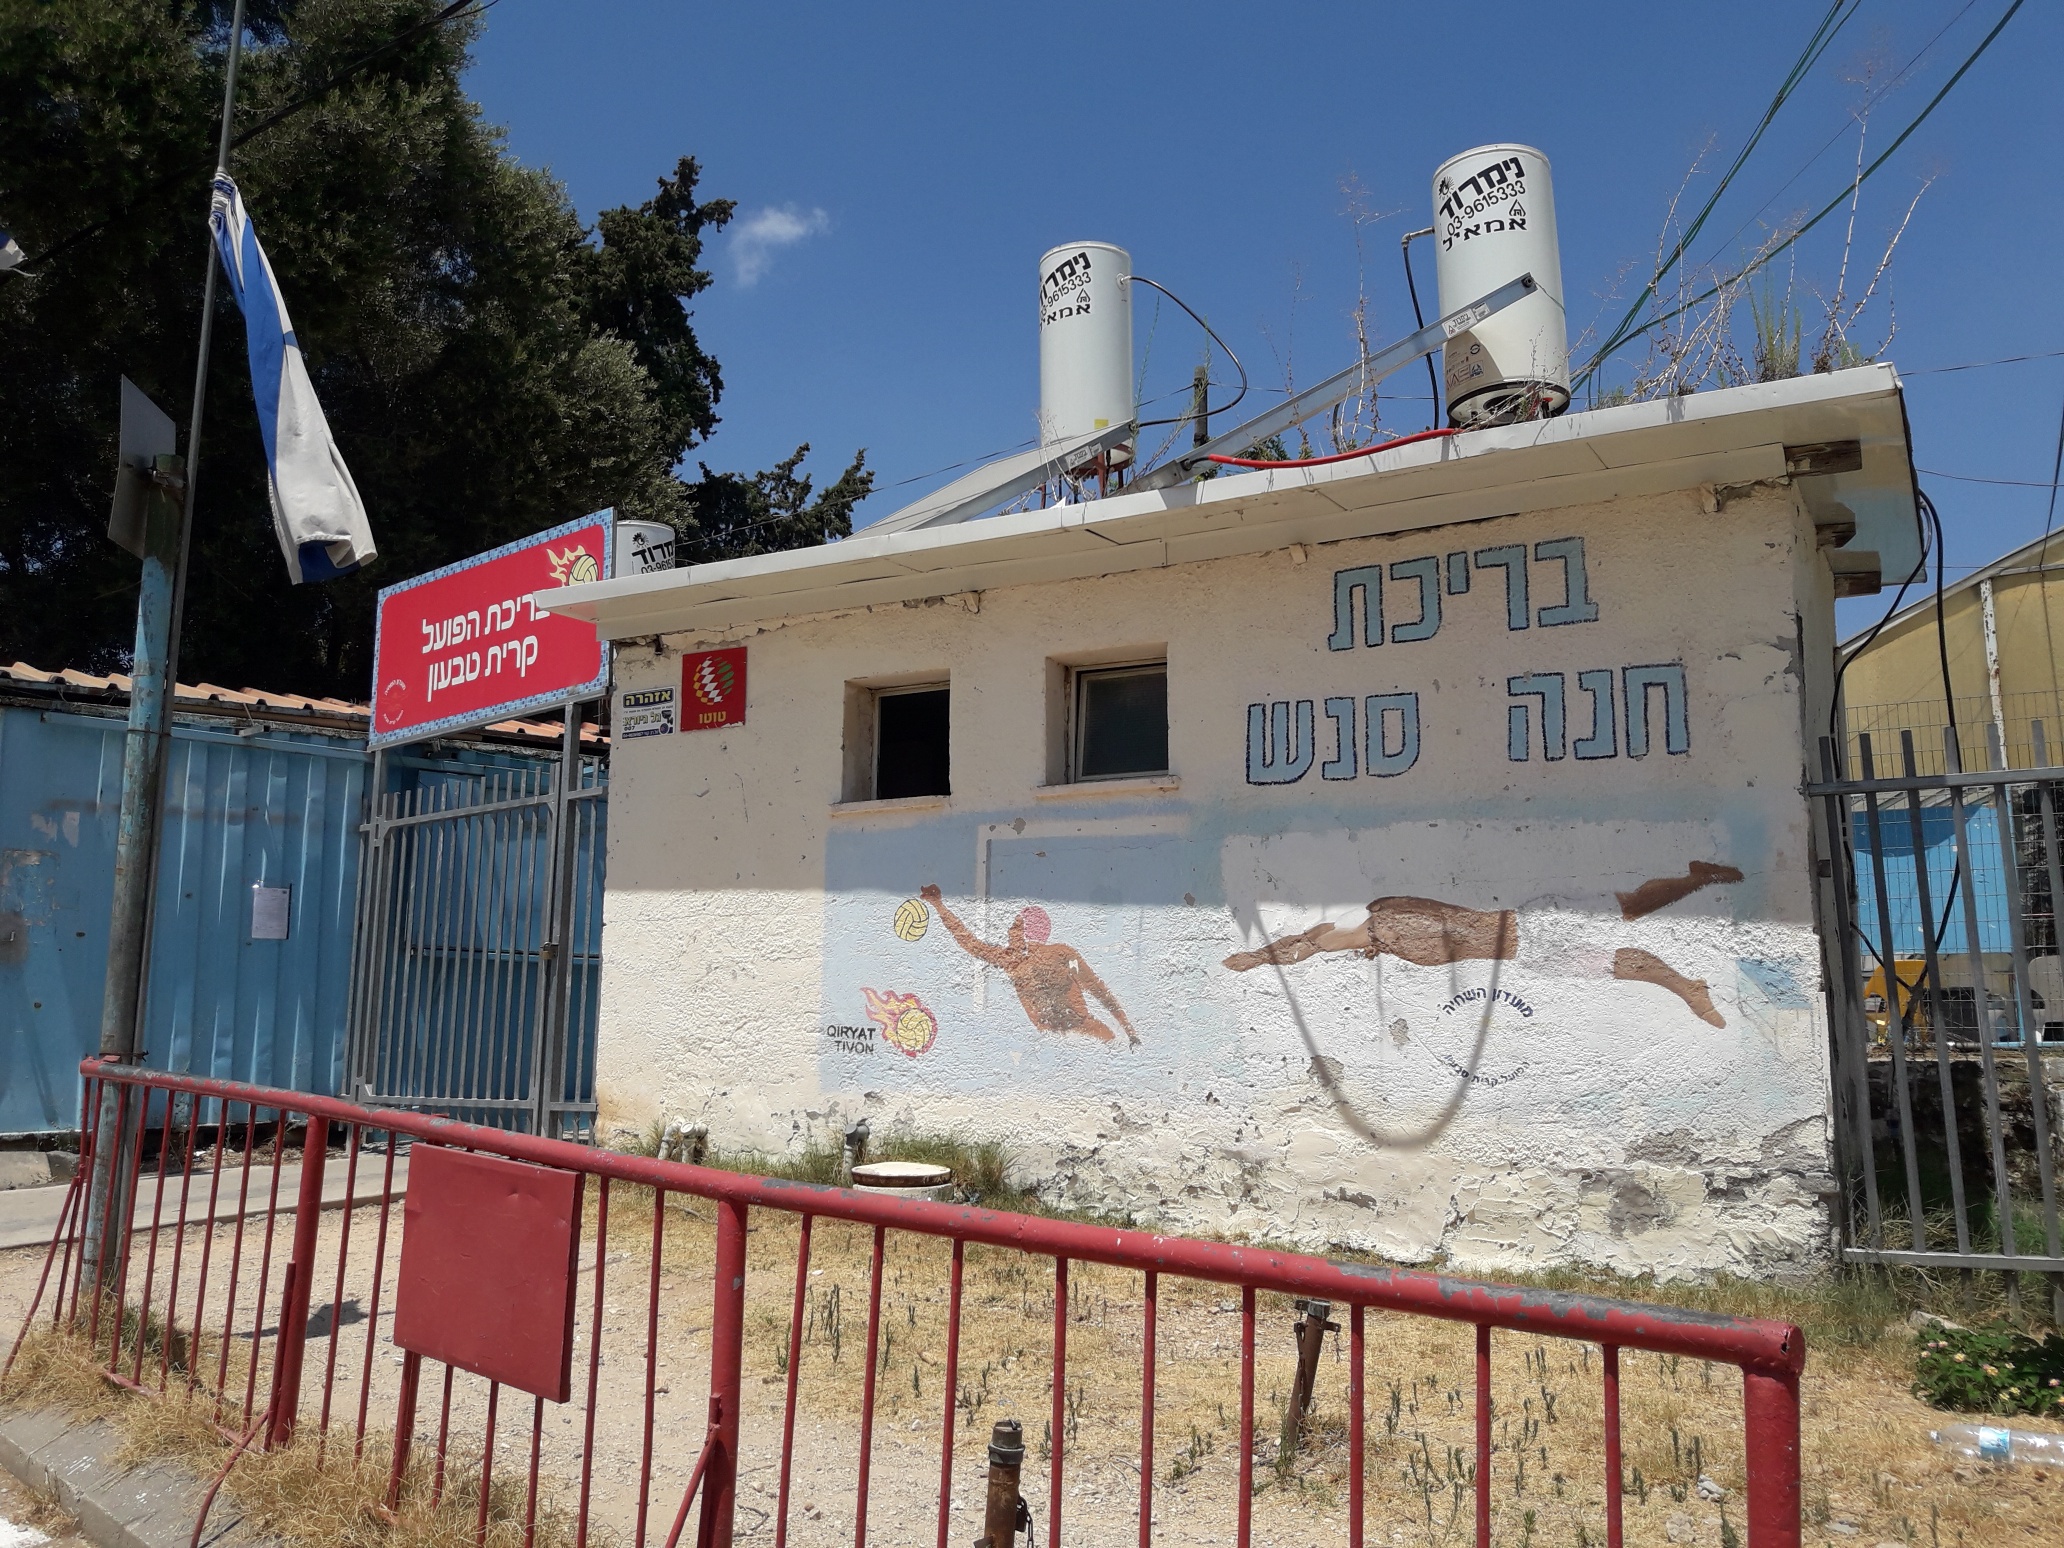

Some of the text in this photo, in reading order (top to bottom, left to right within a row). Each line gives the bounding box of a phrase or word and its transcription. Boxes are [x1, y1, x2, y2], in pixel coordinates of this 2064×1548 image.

[1439, 157, 1525, 219] נימרוד
[1447, 180, 1526, 236] 03-9615333
[1443, 218, 1527, 252] אמאיל
[632, 541, 674, 565] מרוד
[1327, 536, 1599, 652] בריכת
[422, 610, 480, 654] הפועל
[427, 635, 538, 702] קרית טבעון
[625, 690, 671, 706] אזהרה
[699, 711, 726, 724] טוטו
[1246, 663, 1690, 786] חנה סנש
[1442, 988, 1534, 1018] מועדון השחיה
[827, 1025, 876, 1041] QIRYAT
[835, 1040, 874, 1055] TIVON
[1501, 1061, 1530, 1083] הפועל
